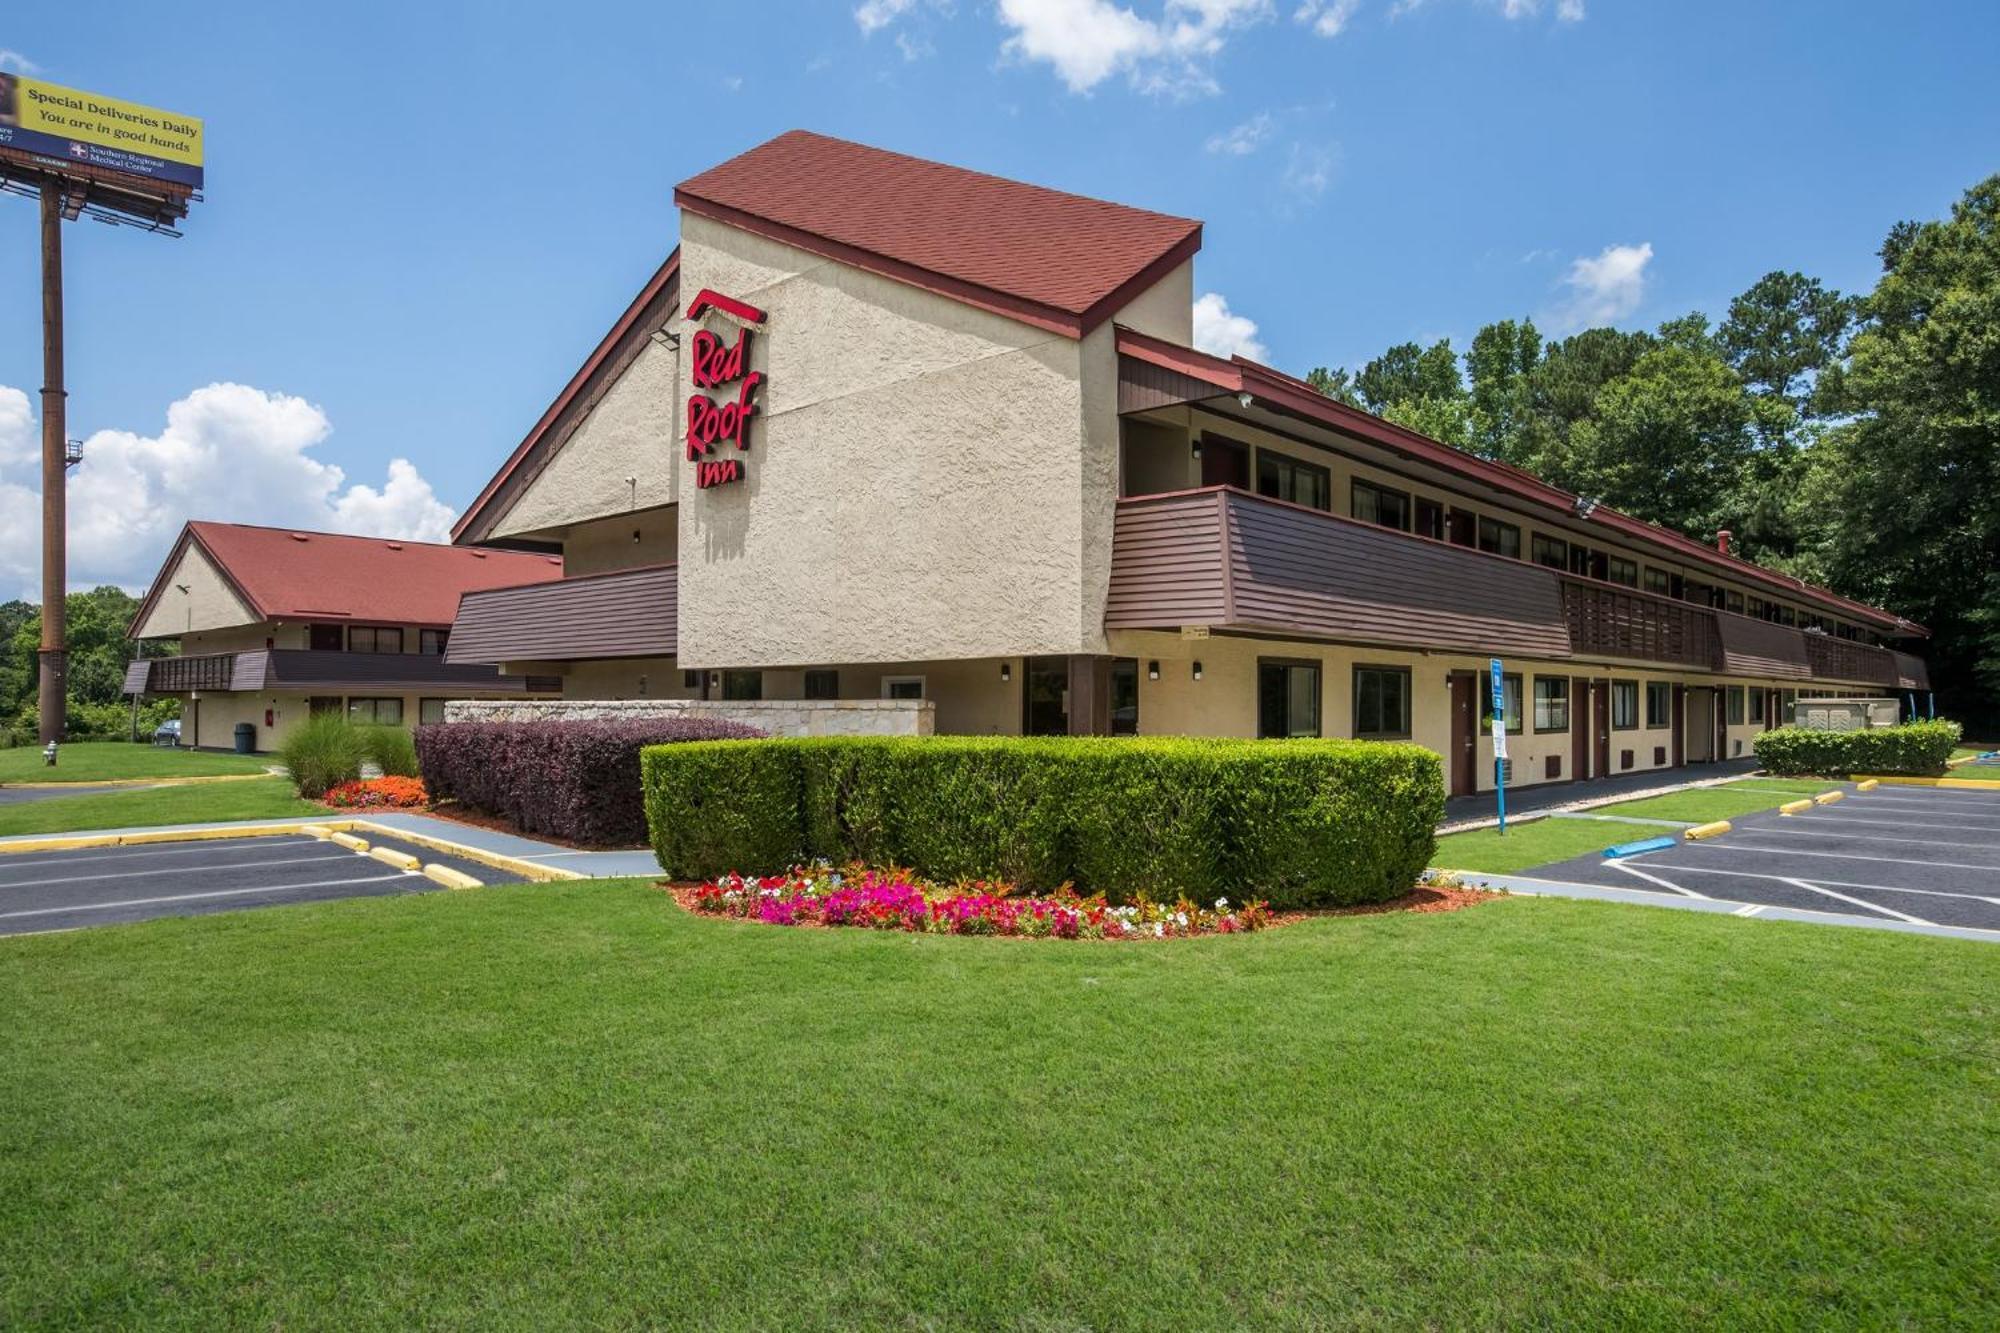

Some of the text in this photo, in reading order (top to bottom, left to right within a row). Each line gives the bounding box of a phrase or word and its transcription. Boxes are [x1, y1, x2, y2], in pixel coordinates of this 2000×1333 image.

[28, 88, 198, 138] Special Deliveries Daily
[39, 110, 191, 153] You are in good hands
[89, 145, 165, 168] Southern Regional
[90, 153, 153, 173] Medical Center
[693, 328, 751, 389] Red
[687, 371, 766, 461] Roof
